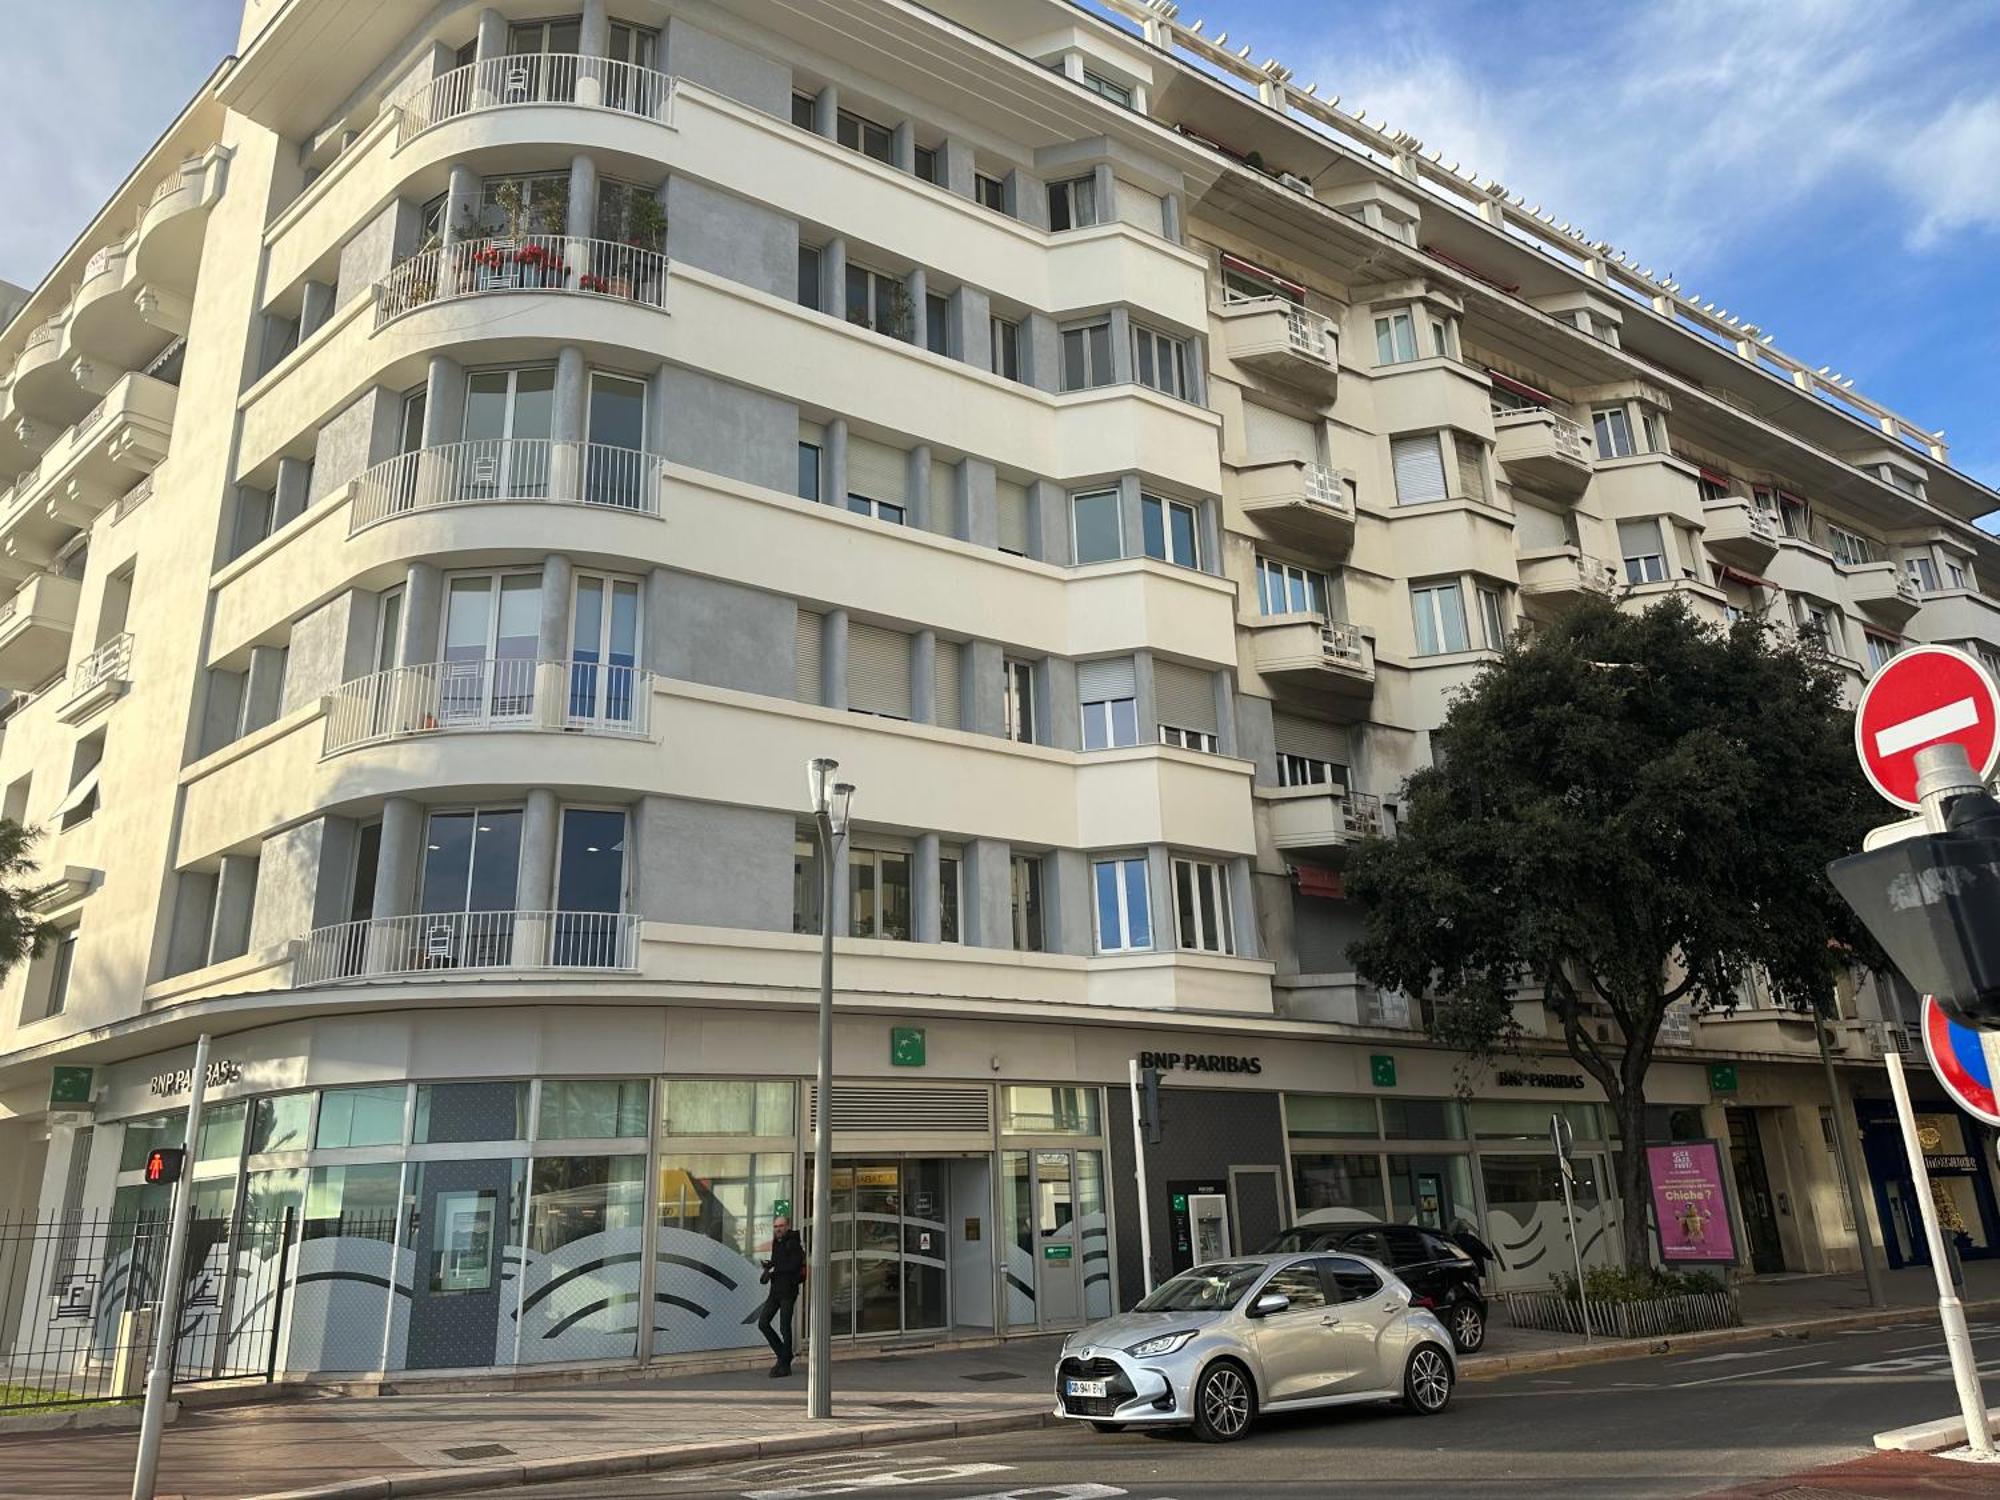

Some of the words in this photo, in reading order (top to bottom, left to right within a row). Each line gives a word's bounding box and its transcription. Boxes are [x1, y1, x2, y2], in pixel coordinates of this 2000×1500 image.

[1140, 1051, 1180, 1070] BNP
[1184, 1054, 1262, 1074] PARIBAS
[151, 1073, 175, 1096] BNP
[175, 1060, 230, 1090] PABAS
[1497, 1071, 1528, 1087] BNP
[1529, 1073, 1585, 1089] PARIBAS
[1665, 1190, 1704, 1201] Chiche
